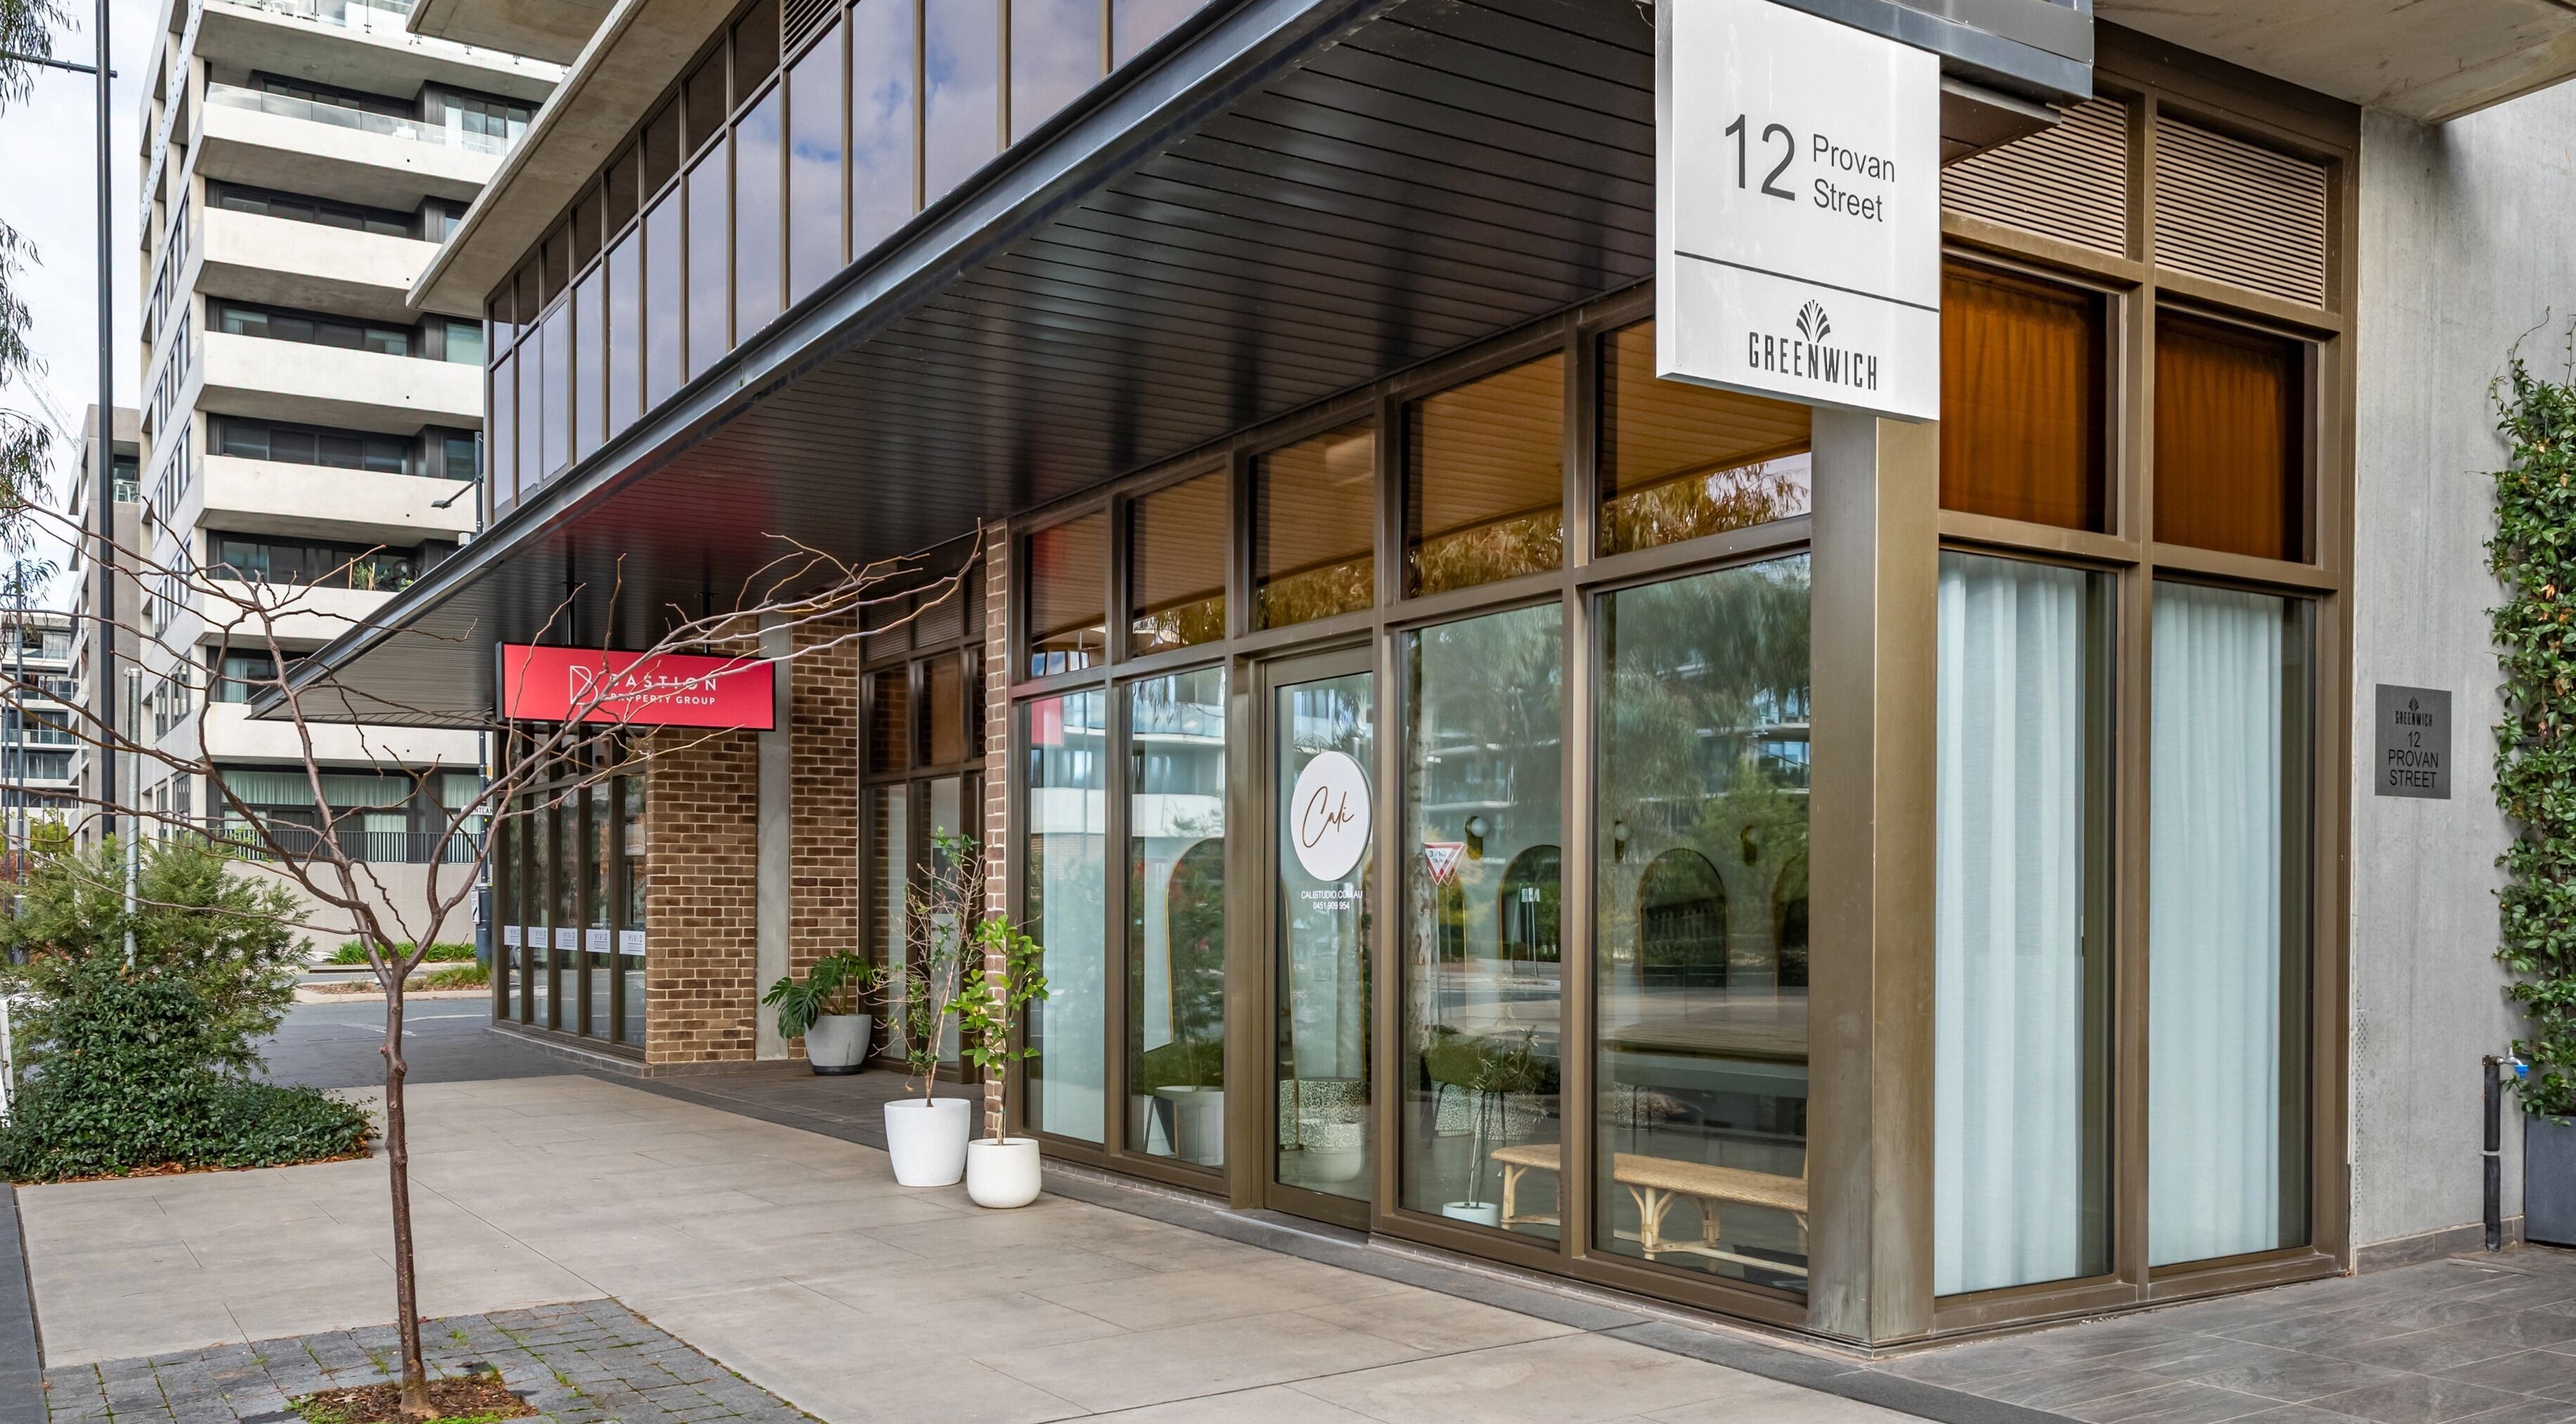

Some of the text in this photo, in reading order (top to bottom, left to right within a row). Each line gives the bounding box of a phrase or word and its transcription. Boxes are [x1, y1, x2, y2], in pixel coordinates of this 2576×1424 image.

[1725, 113, 1796, 202] 12
[1812, 134, 1895, 183] Provan
[1813, 178, 1883, 223] Street
[1749, 331, 1877, 391] GREENWICH
[610, 673, 716, 691] BASTION
[676, 696, 716, 705] GROUP
[2395, 711, 2433, 727] GREENWICH
[2408, 731, 2421, 748] 12
[2388, 749, 2438, 768] PROVAN
[2390, 769, 2437, 788] STREET
[1302, 786, 1355, 848] Cali
[1301, 890, 1363, 900] CALISTUDIO.COM.AU
[1313, 901, 1350, 910] 0451 909 954
[628, 934, 643, 943] VIVID
